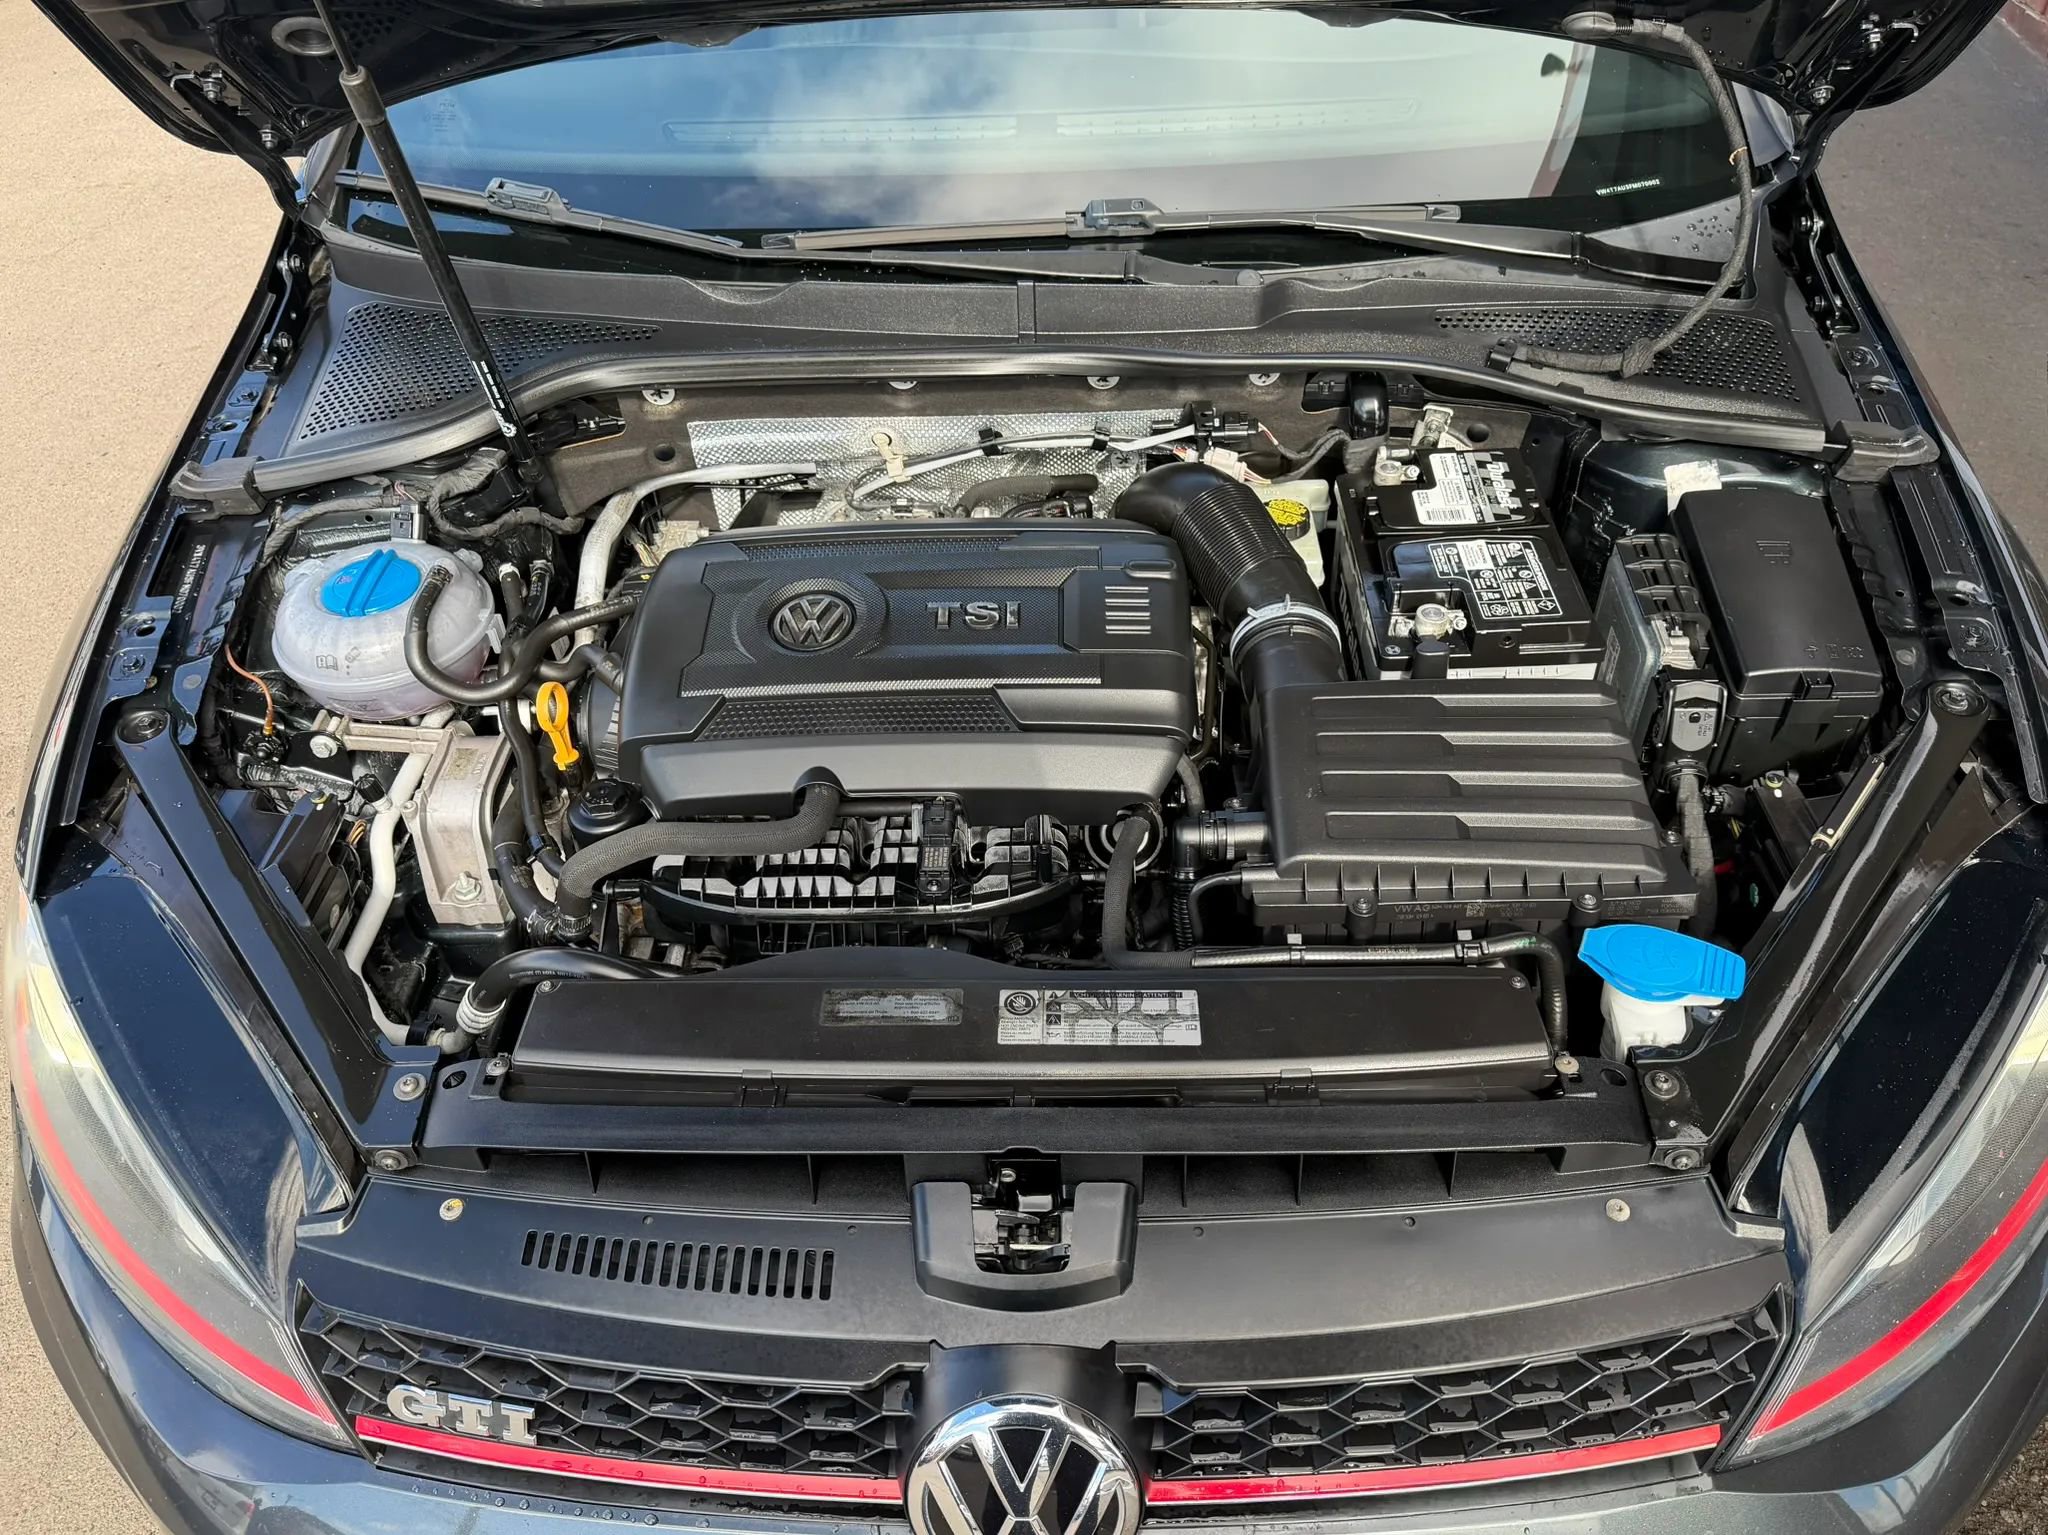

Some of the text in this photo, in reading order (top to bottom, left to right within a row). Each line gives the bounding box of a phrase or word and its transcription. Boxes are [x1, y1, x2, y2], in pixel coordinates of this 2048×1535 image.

[1486, 461, 1519, 510] Duralast
[773, 592, 853, 651] VW
[926, 600, 1021, 630] TSI
[387, 1384, 537, 1446] GTI
